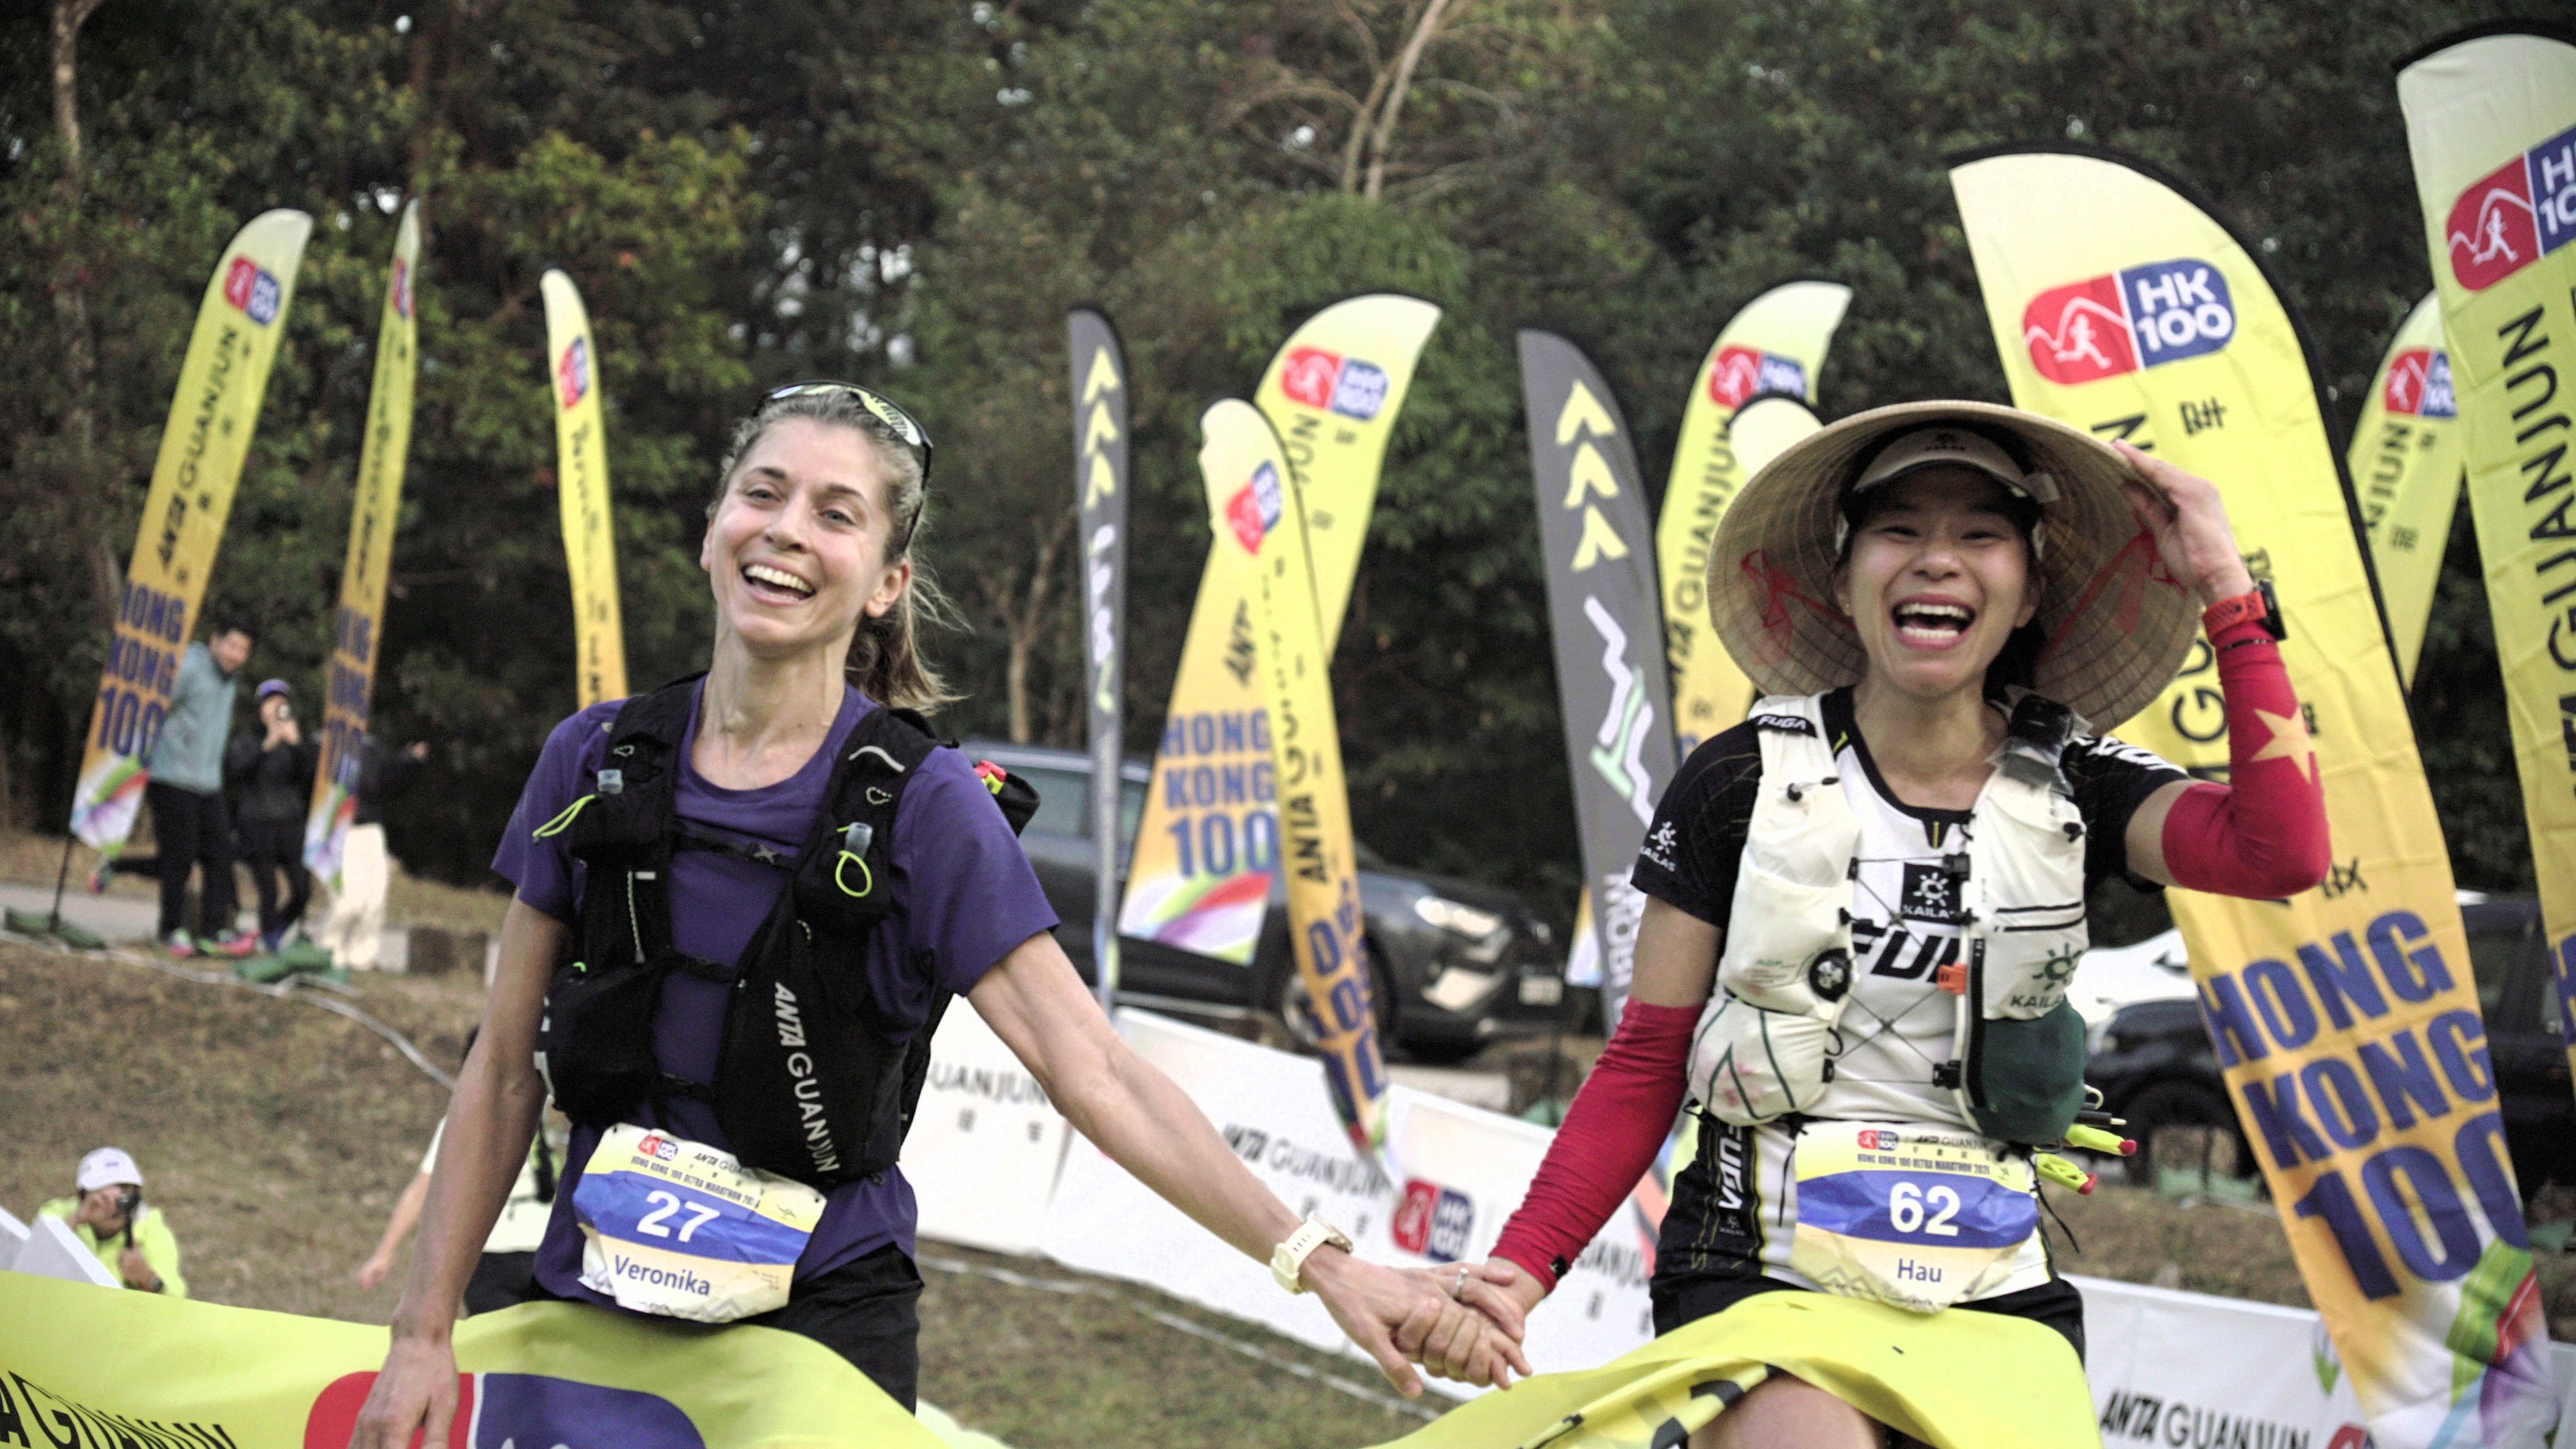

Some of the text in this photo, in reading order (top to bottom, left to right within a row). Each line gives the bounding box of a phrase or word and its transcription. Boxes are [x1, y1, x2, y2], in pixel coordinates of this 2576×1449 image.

[2541, 143, 2576, 194] H
[2539, 181, 2576, 235] 10
[2136, 267, 2217, 314] HK
[2136, 302, 2233, 352] 100
[1161, 707, 1271, 758] HONG
[1164, 761, 1277, 809] KONG
[1167, 809, 1282, 879] 100
[1902, 903, 1955, 919] KAILA
[2010, 992, 2068, 1008] KAILA
[2198, 909, 2455, 1069] HONG
[774, 981, 840, 1173] ANTA GUANJUN
[2242, 1009, 2499, 1170] KONG
[1858, 1153, 1876, 1164] HONG
[1878, 1155, 1897, 1166] KONG
[1934, 1160, 1972, 1173] MARATHON
[636, 1189, 721, 1243] 27
[1888, 1180, 1962, 1238] 62
[2294, 1111, 2530, 1302] 100
[613, 1253, 711, 1297] Veronika
[1896, 1257, 1943, 1284] Hau
[2099, 1381, 2311, 1449] ANTA GUANJUN
